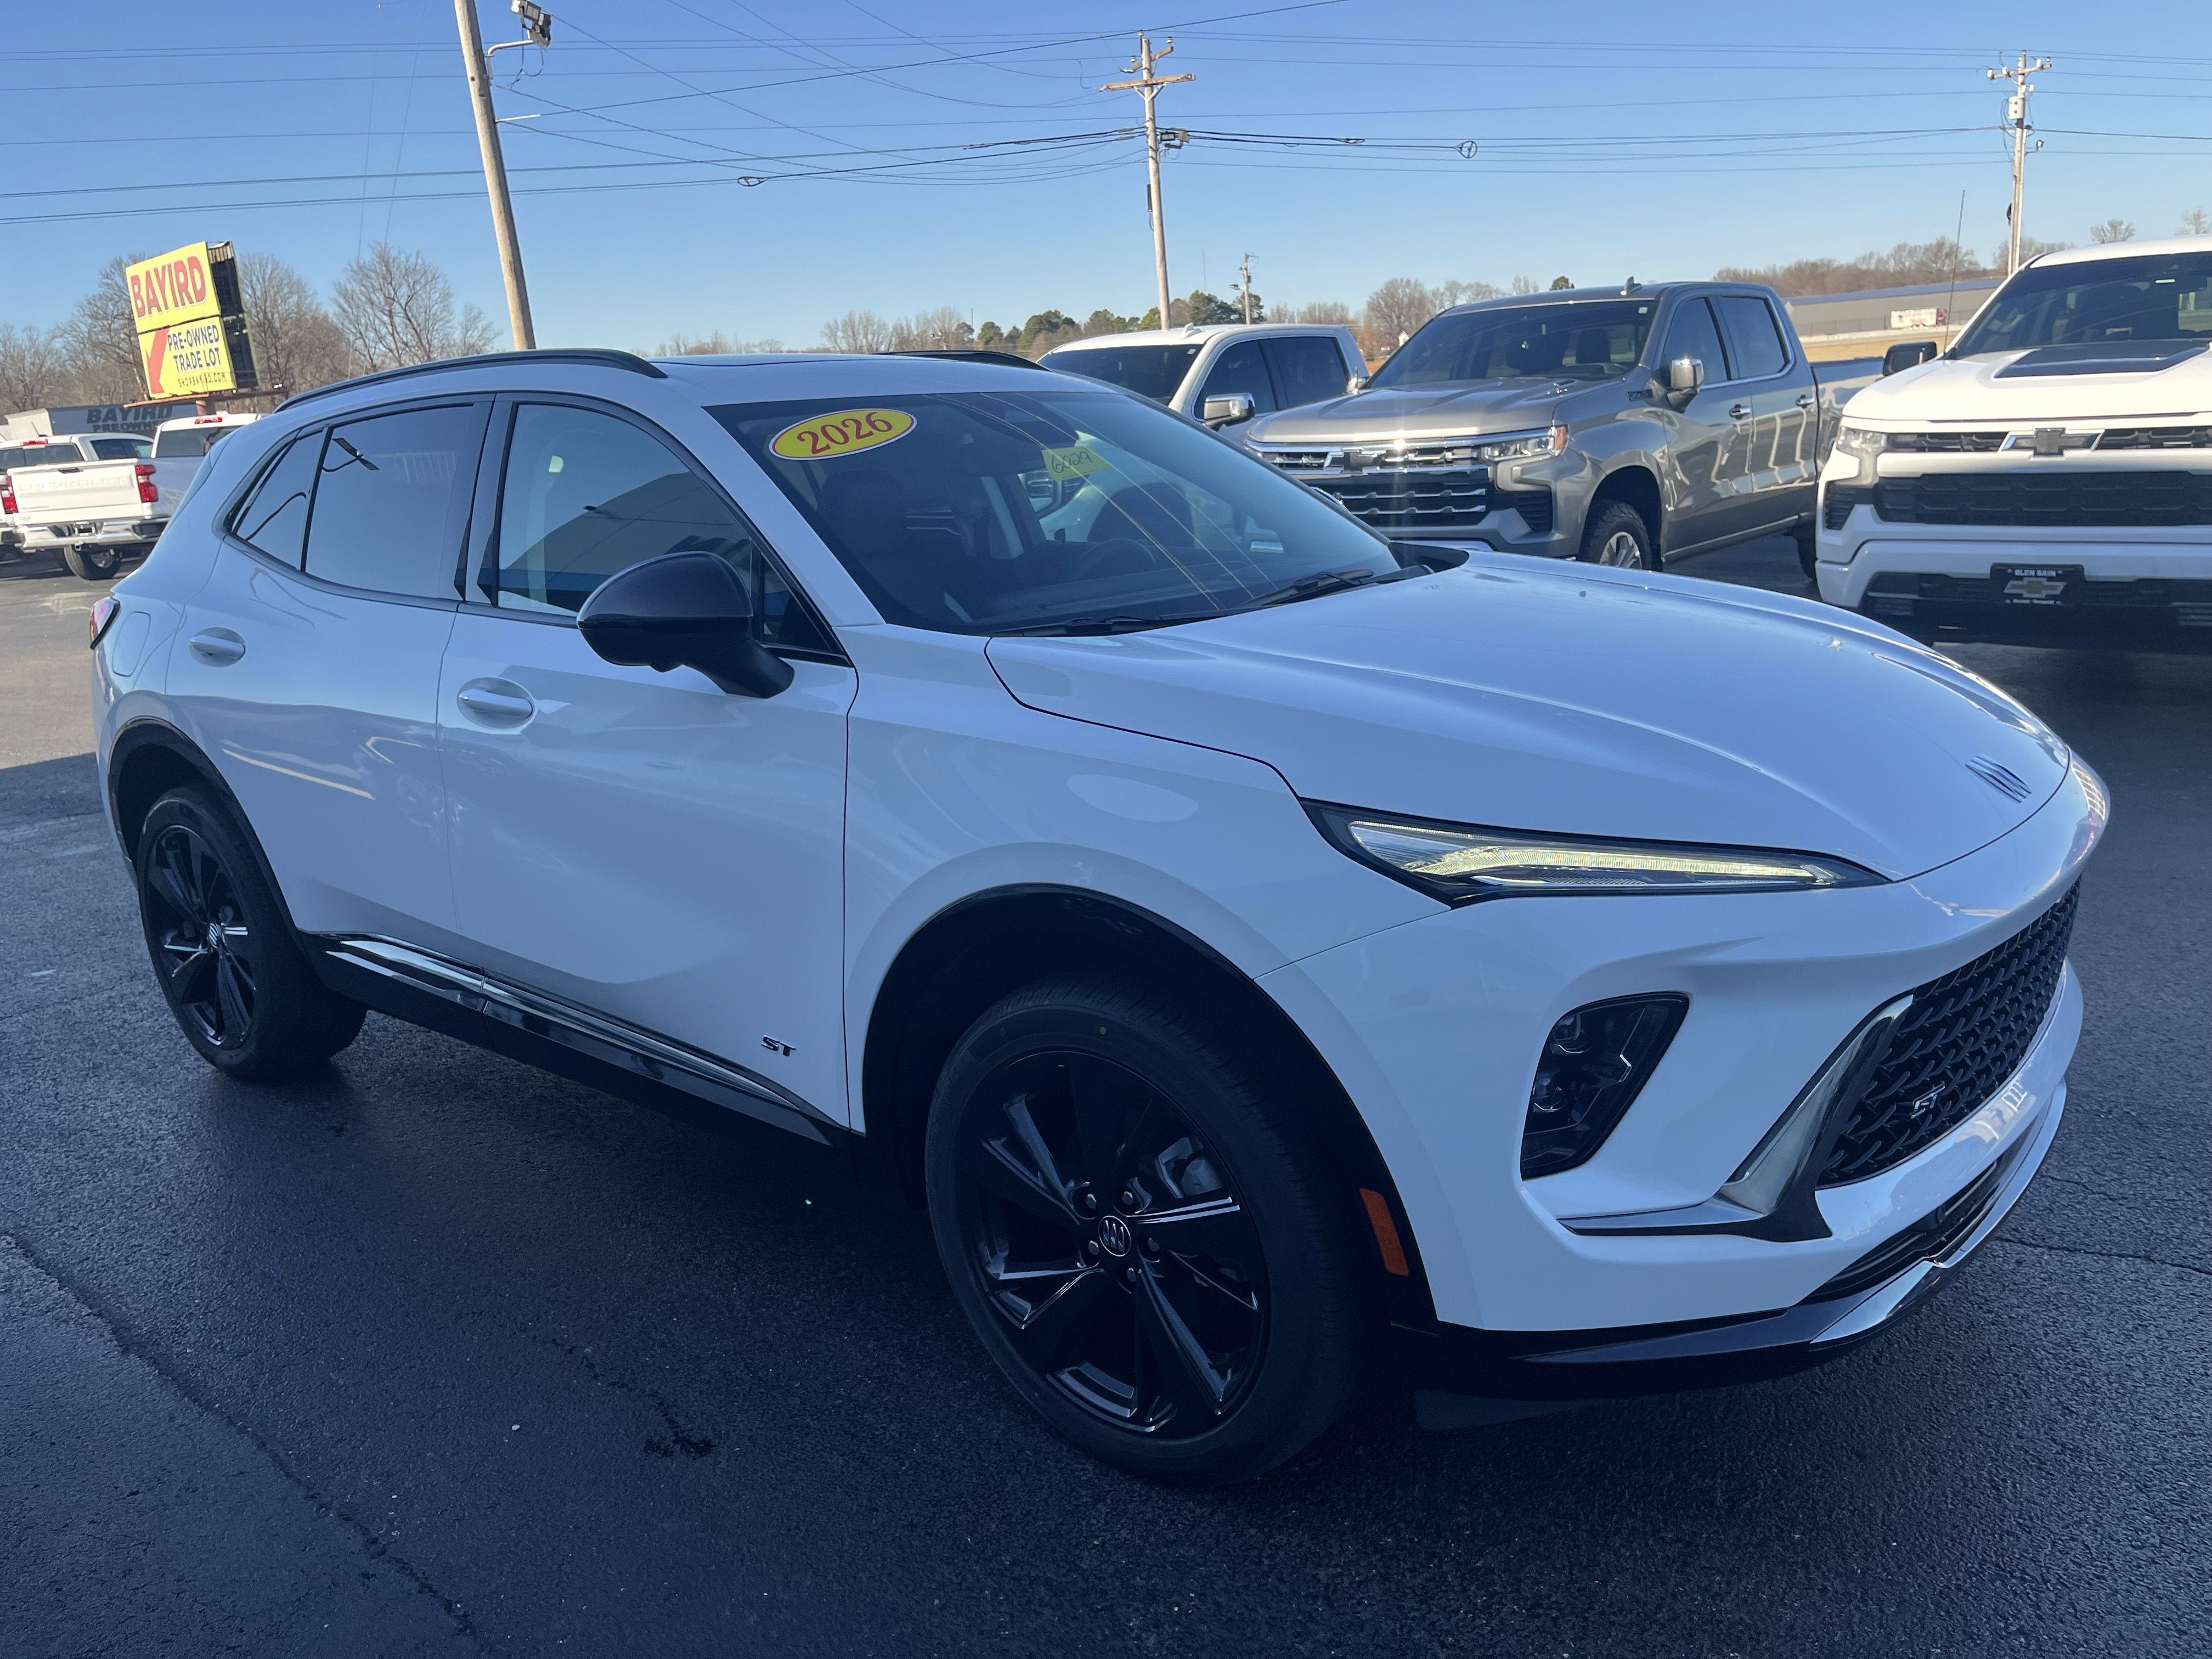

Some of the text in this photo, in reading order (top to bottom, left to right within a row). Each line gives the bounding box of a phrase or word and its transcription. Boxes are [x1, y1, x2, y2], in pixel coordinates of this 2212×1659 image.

[131, 256, 206, 318] BAYIRD
[167, 324, 219, 351] PRE-OWNED
[173, 347, 221, 371] TRADE LOT
[86, 405, 173, 424] BAYIRD
[797, 411, 893, 455] 2026
[1051, 451, 1094, 474] 6029
[760, 1035, 797, 1057] ST
